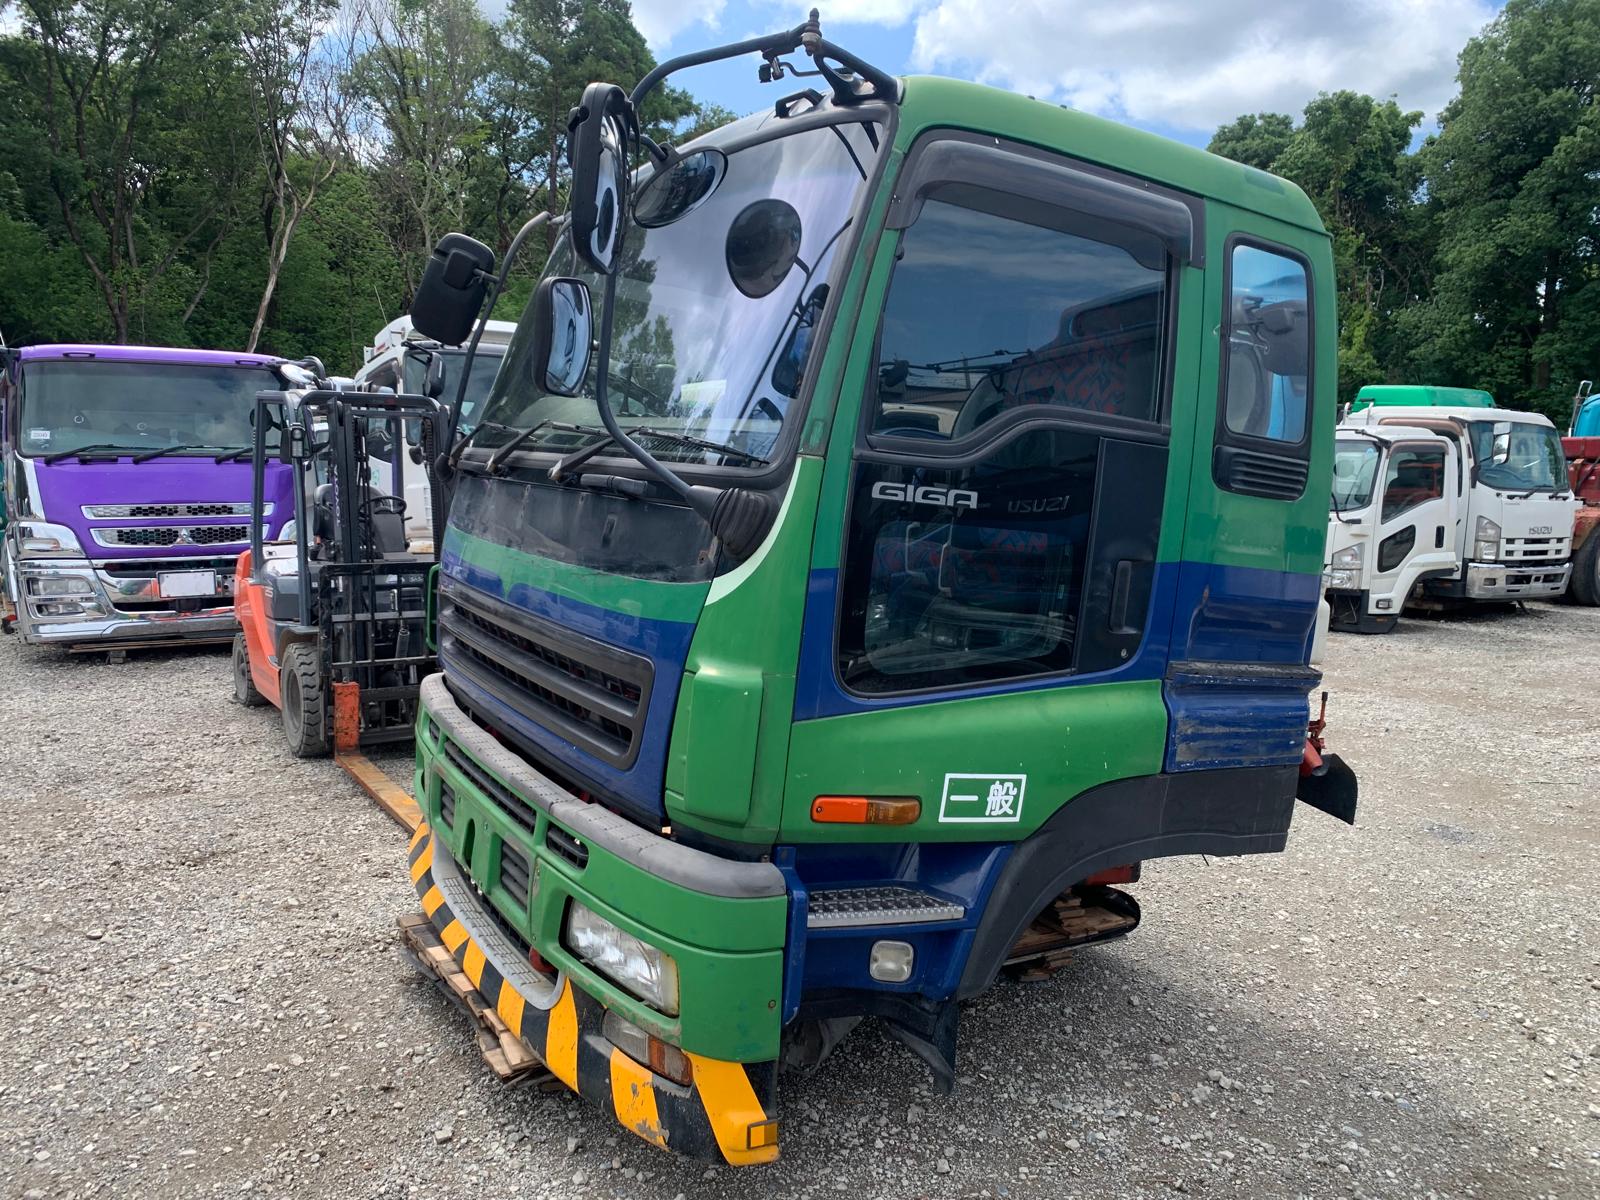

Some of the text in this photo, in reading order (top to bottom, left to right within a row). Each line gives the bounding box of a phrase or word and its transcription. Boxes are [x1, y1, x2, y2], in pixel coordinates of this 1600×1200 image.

[871, 481, 979, 510] GIGA
[1529, 525, 1553, 536] ISUZU
[949, 780, 1018, 817] 一般
